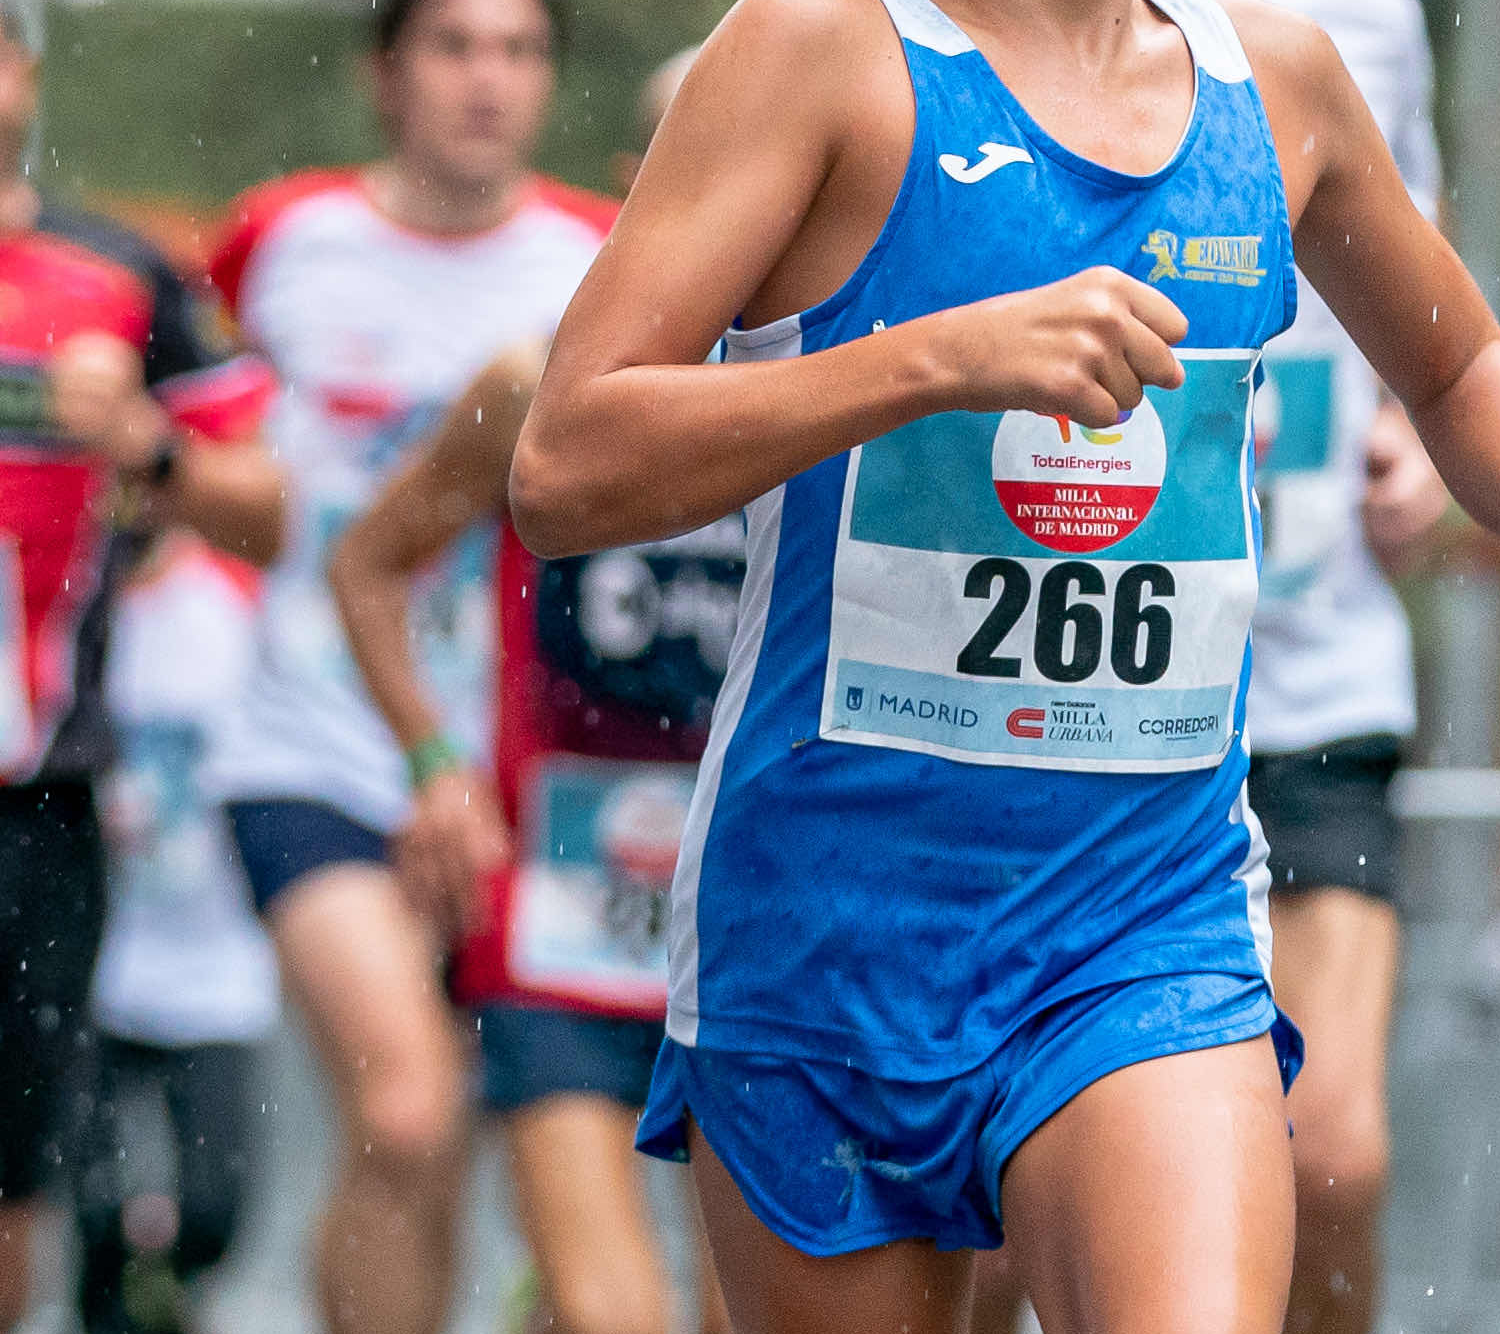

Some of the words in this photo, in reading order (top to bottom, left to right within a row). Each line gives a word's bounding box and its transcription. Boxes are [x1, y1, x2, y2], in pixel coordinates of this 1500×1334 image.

[1032, 454, 1132, 473] TotalEnergies
[1054, 488, 1102, 503] MILLA
[1034, 521, 1055, 535] DE
[1059, 522, 1119, 537] MADRID
[956, 556, 1176, 686] 266
[879, 694, 979, 728] MADRID
[1050, 710, 1106, 726] MILLA
[1048, 727, 1113, 743] URBANA
